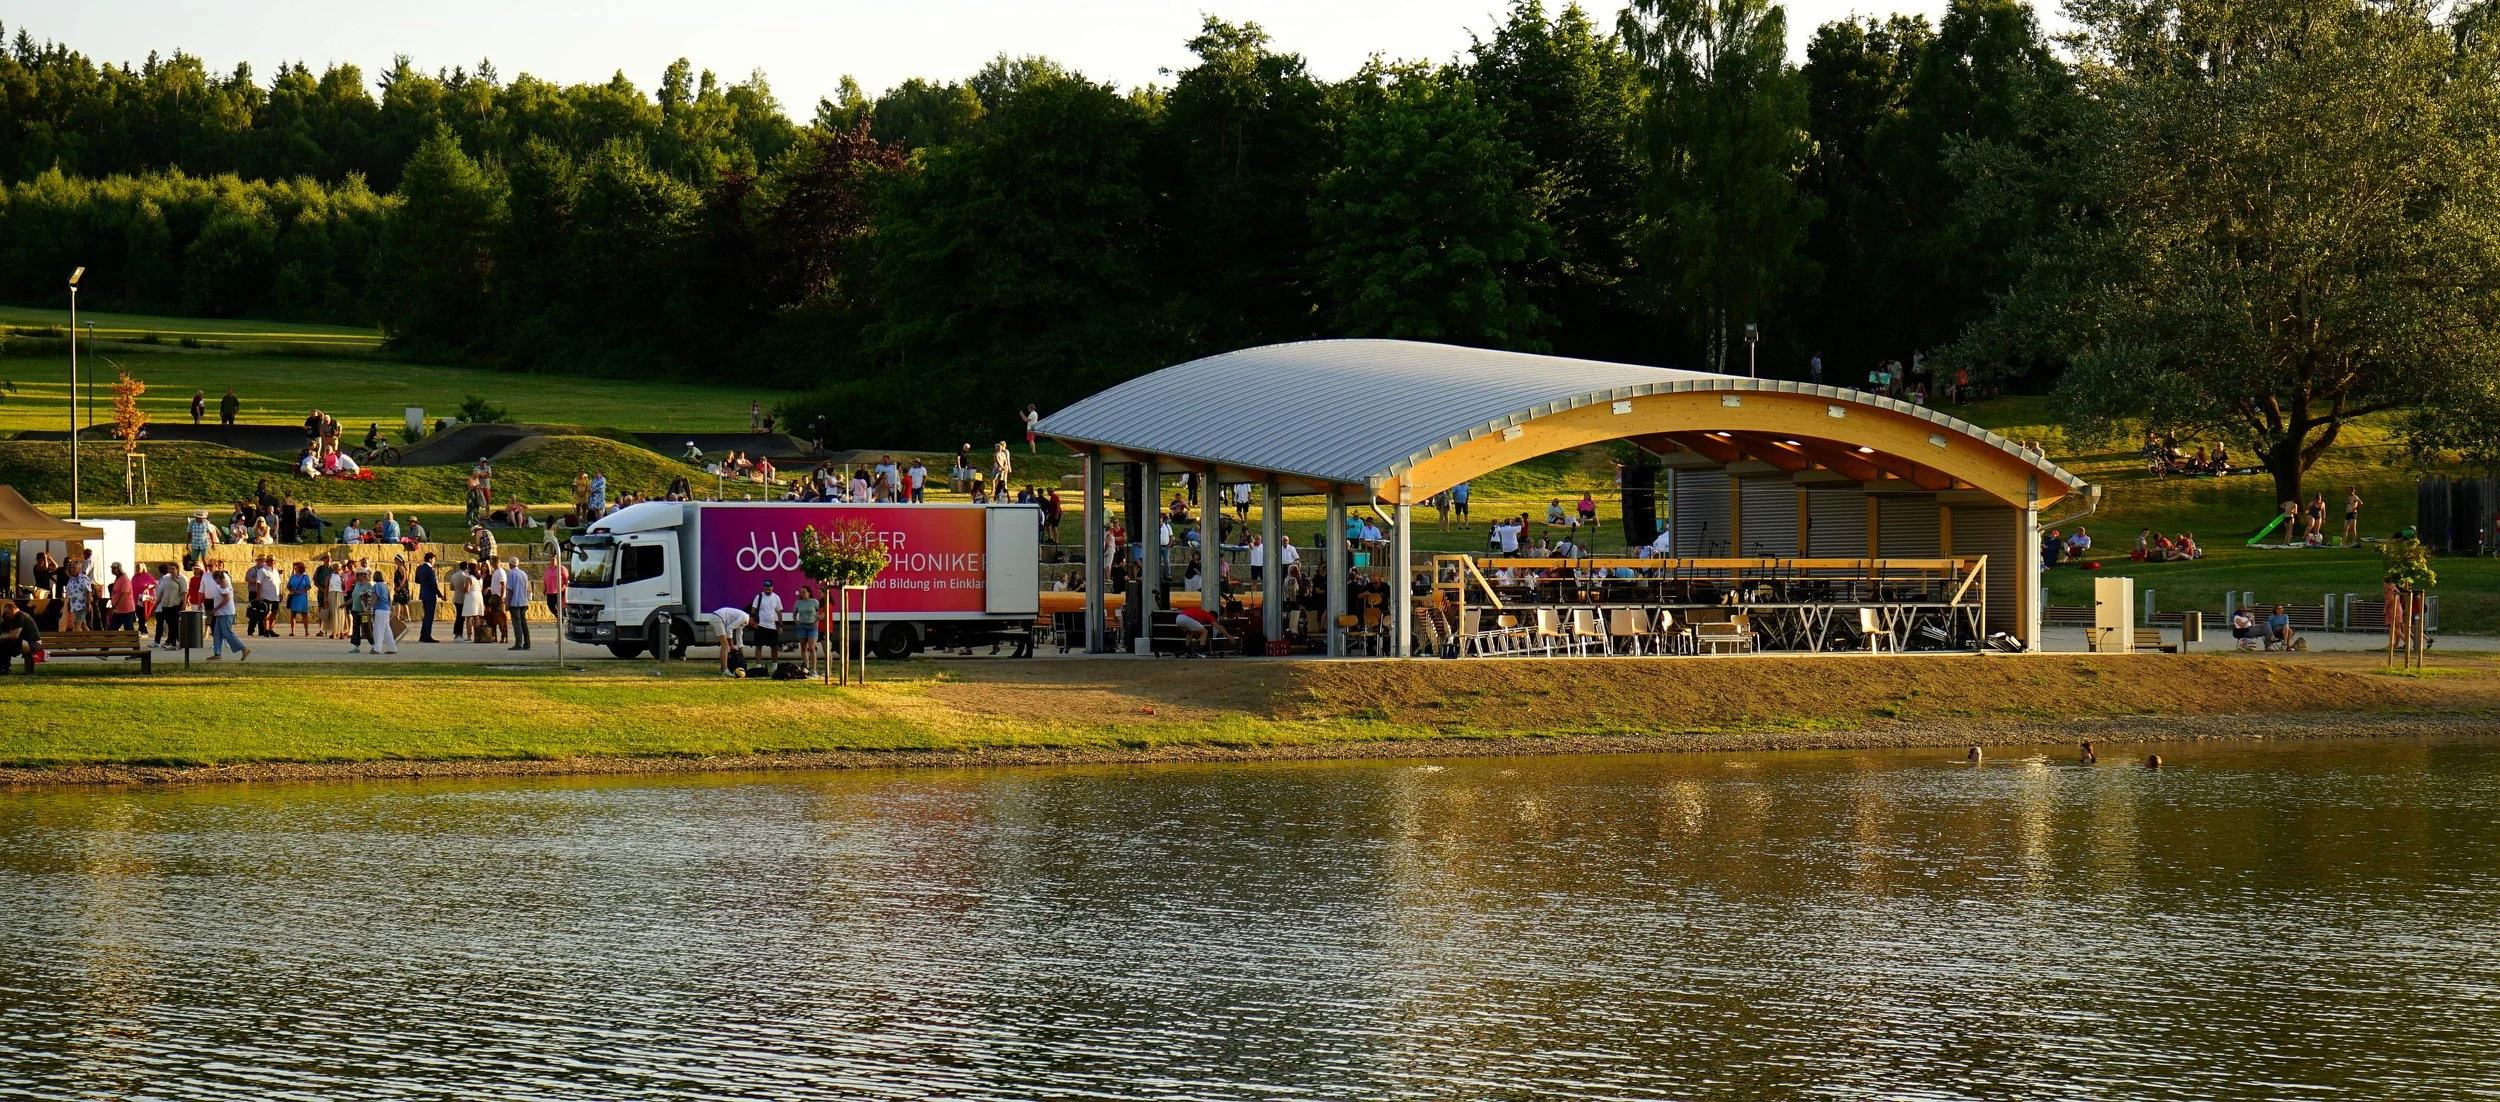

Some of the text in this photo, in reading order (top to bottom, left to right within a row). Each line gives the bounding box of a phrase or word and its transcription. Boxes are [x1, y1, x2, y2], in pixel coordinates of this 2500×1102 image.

[831, 531, 906, 550] HOFER
[879, 553, 986, 572] PHONIKE
[889, 578, 930, 591] Bildung
[933, 578, 947, 589] im
[950, 578, 986, 589] Einkla
